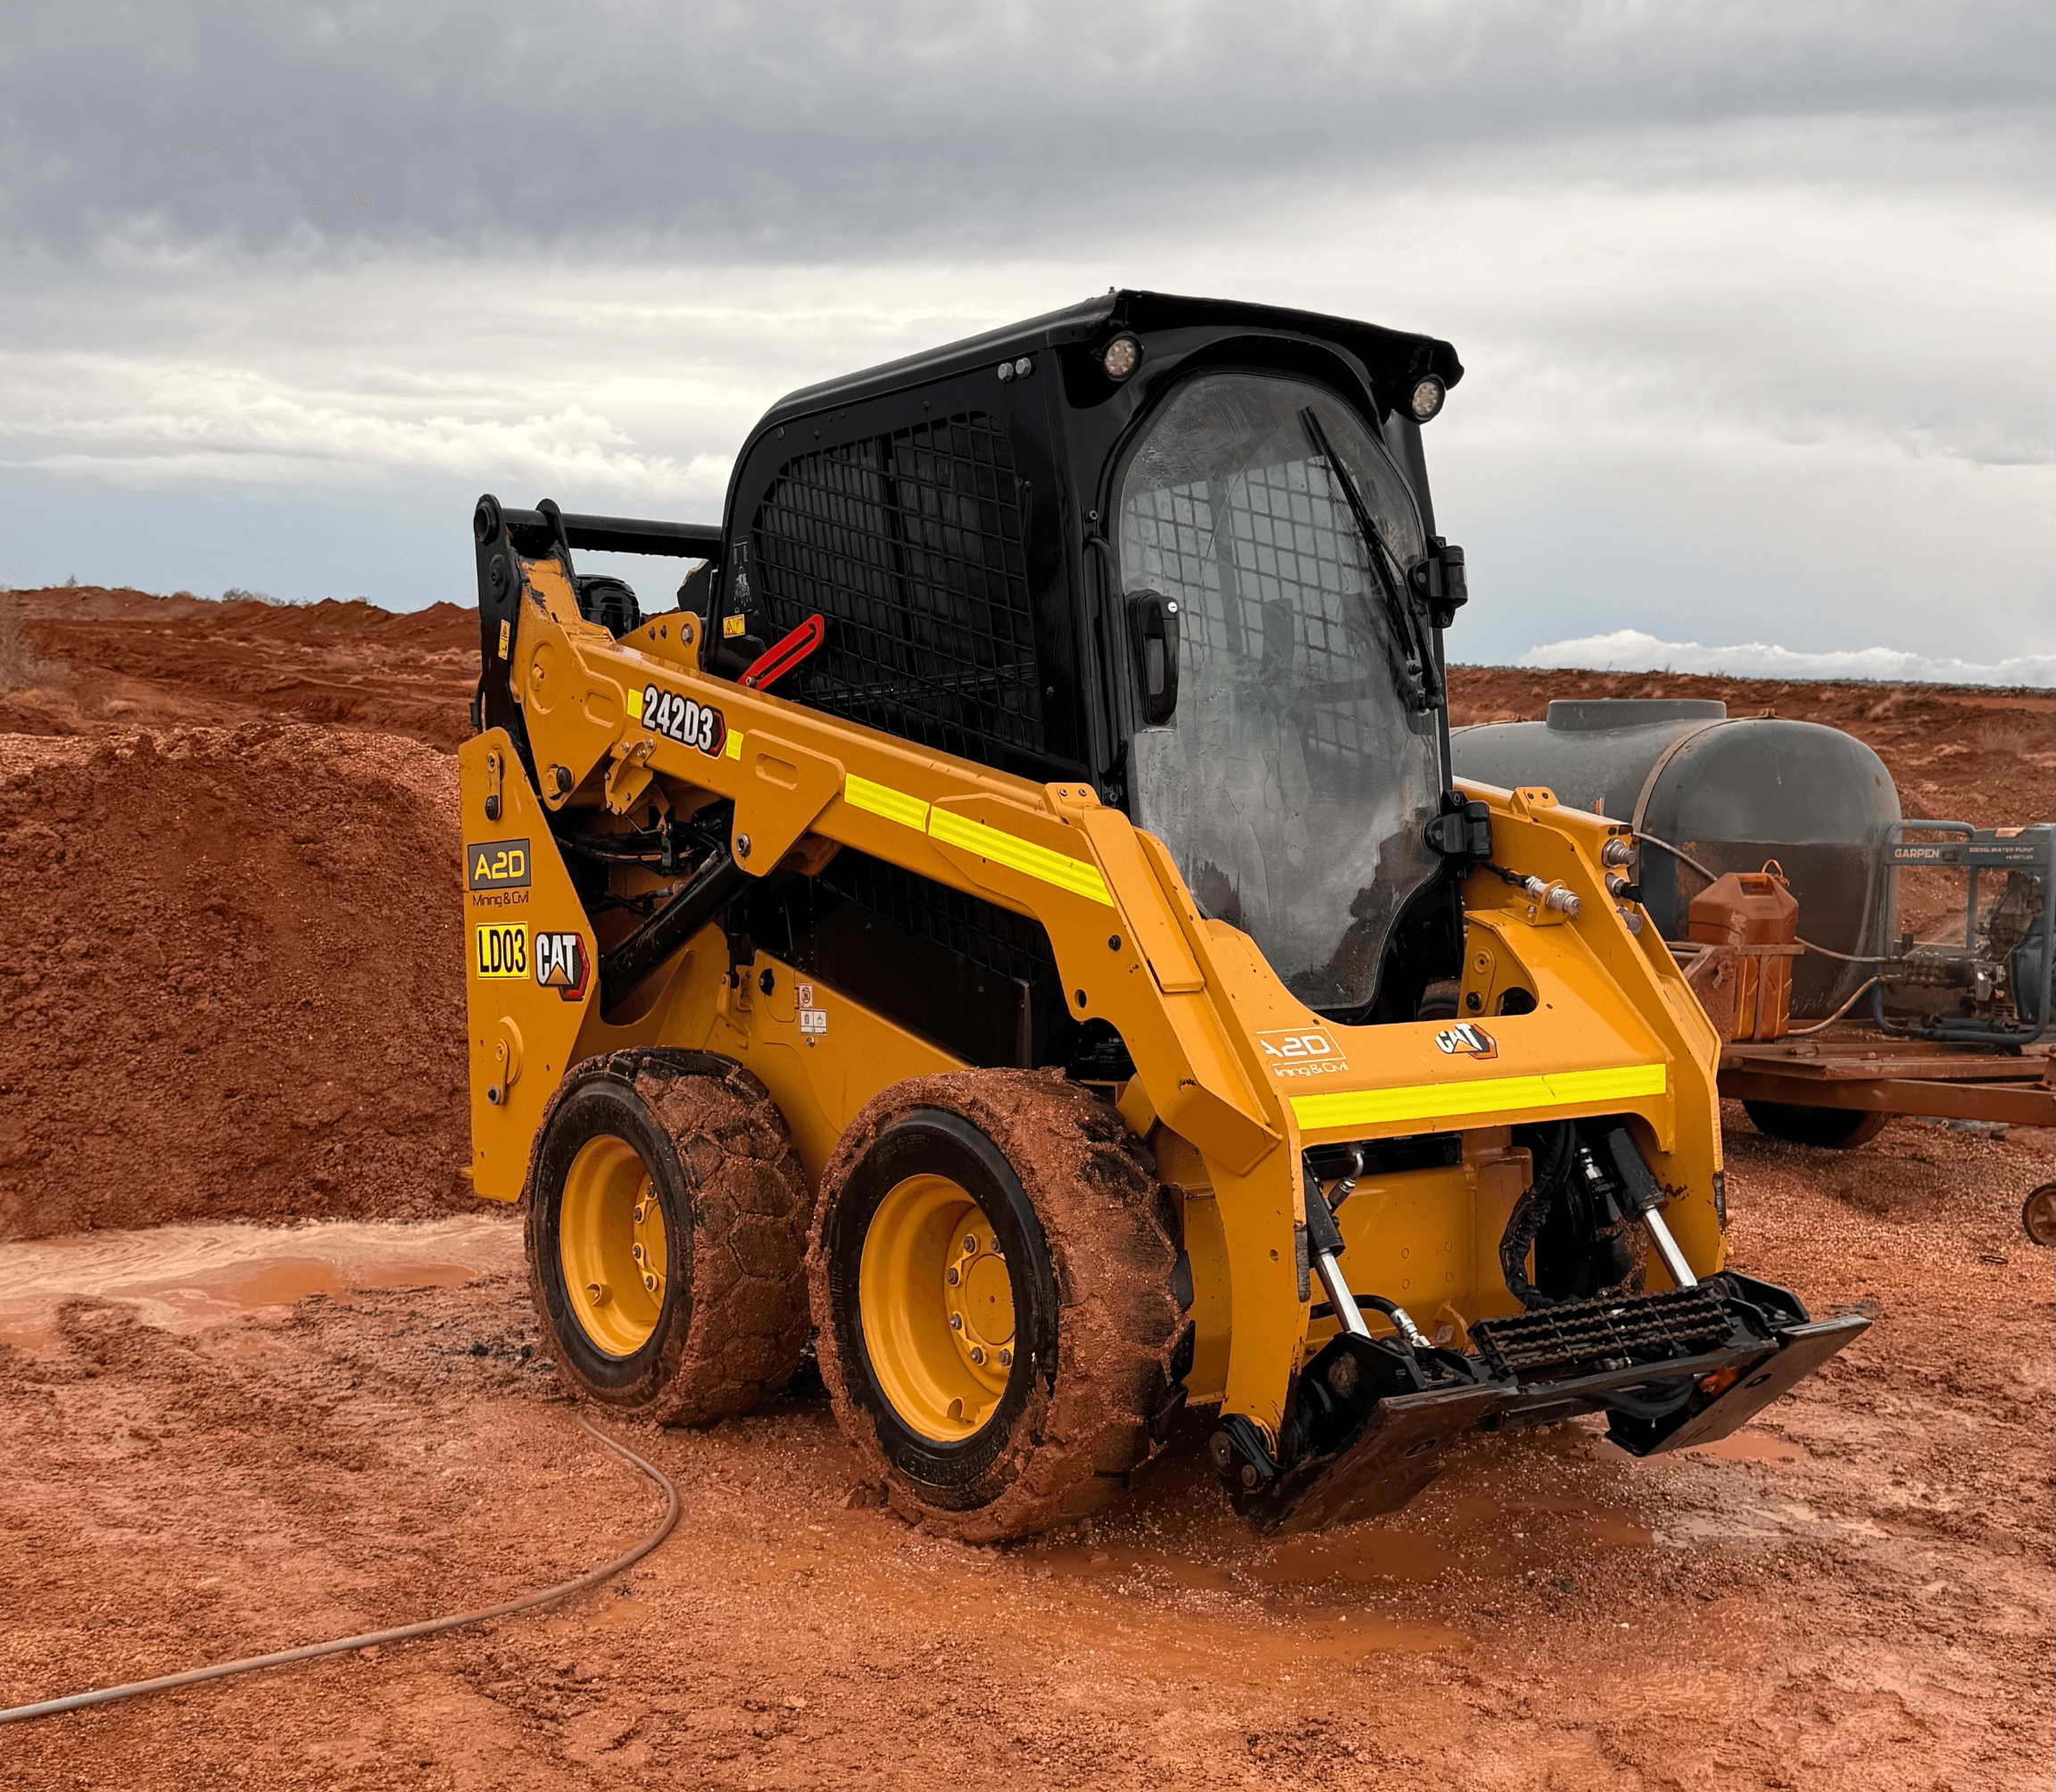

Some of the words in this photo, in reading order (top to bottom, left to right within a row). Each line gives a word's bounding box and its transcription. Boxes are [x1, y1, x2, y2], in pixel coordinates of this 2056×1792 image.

[642, 685, 715, 751] 242D3
[474, 850, 525, 881] A2D
[1894, 848, 1940, 859] GARPEN
[472, 893, 502, 908] Mining
[503, 892, 511, 905] &
[478, 928, 526, 973] LD03
[535, 933, 576, 985] CAT
[1435, 1023, 1483, 1053] CAT
[1309, 1063, 1323, 1074] &
